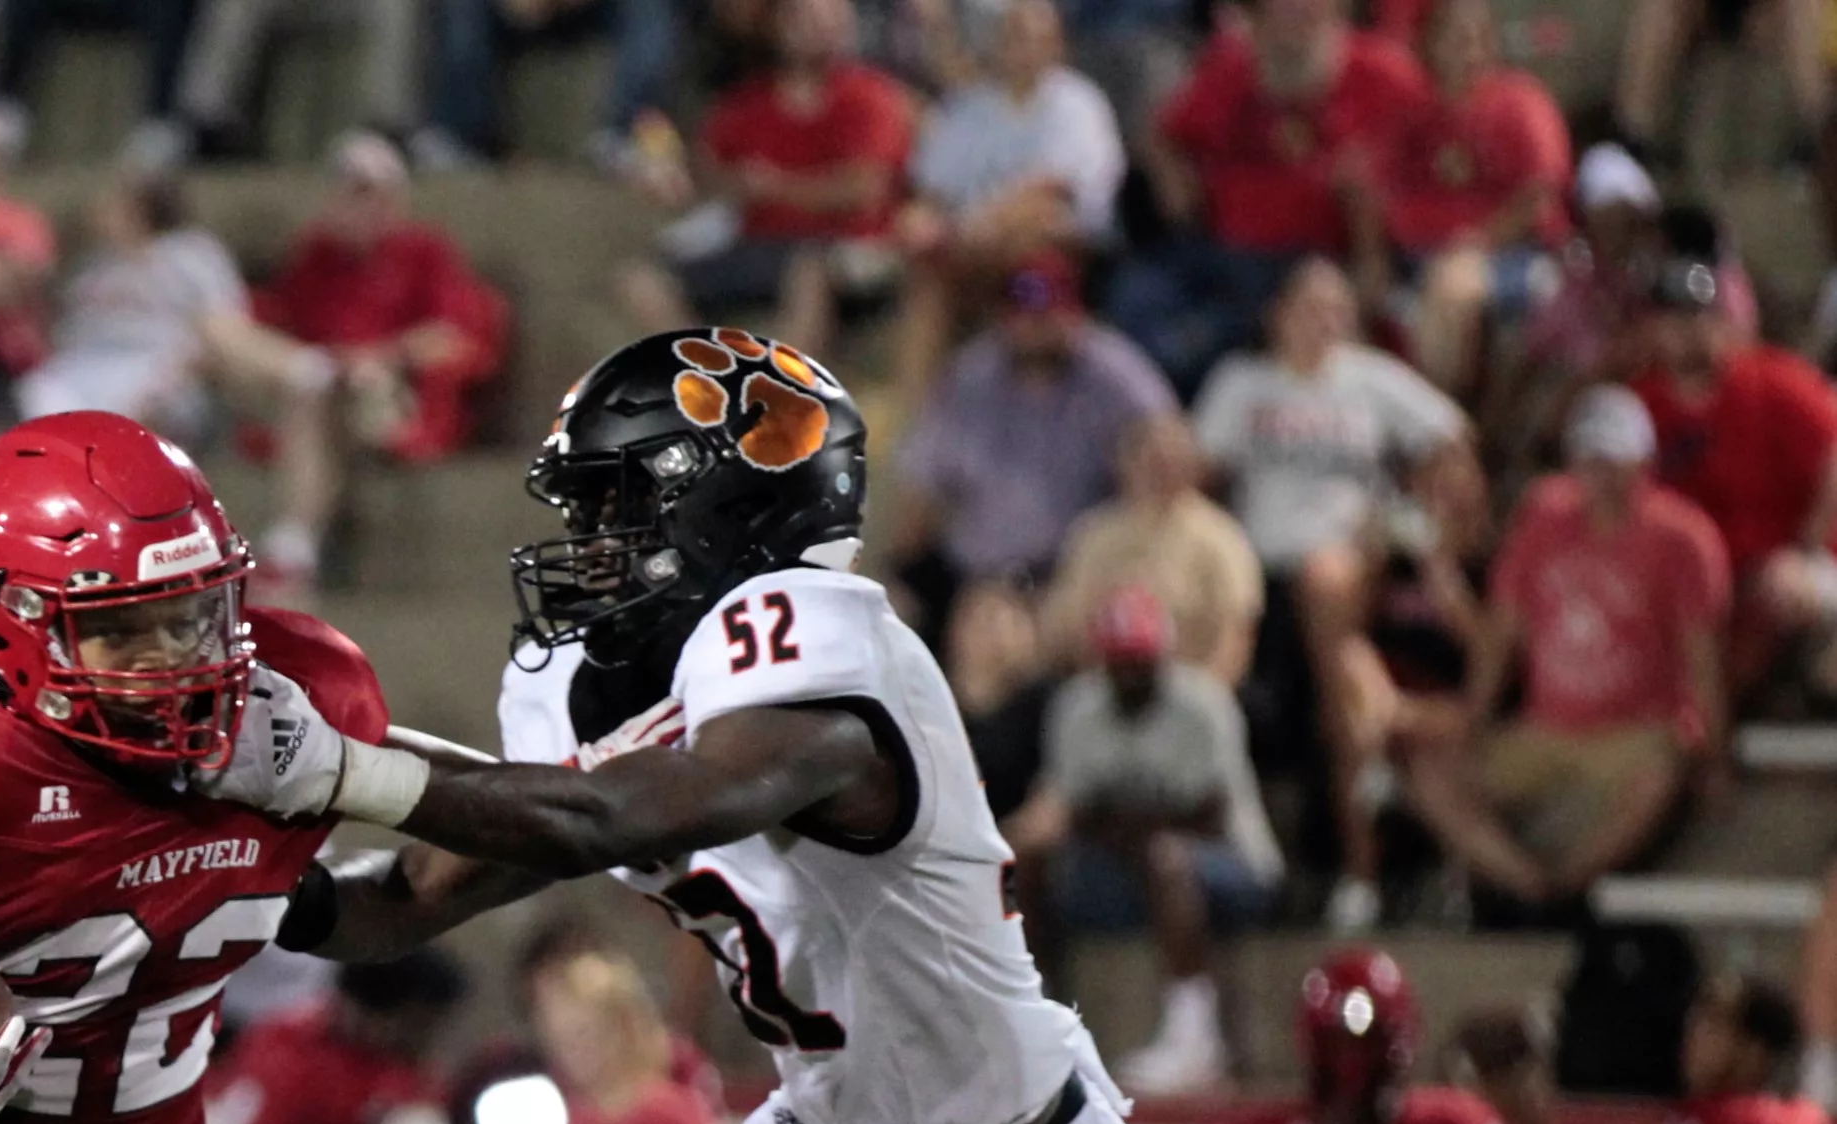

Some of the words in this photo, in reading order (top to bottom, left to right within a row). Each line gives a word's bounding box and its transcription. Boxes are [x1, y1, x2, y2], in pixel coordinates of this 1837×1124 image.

[721, 590, 801, 674] 52
[40, 785, 70, 813] R
[116, 838, 260, 889] MAYFIELD
